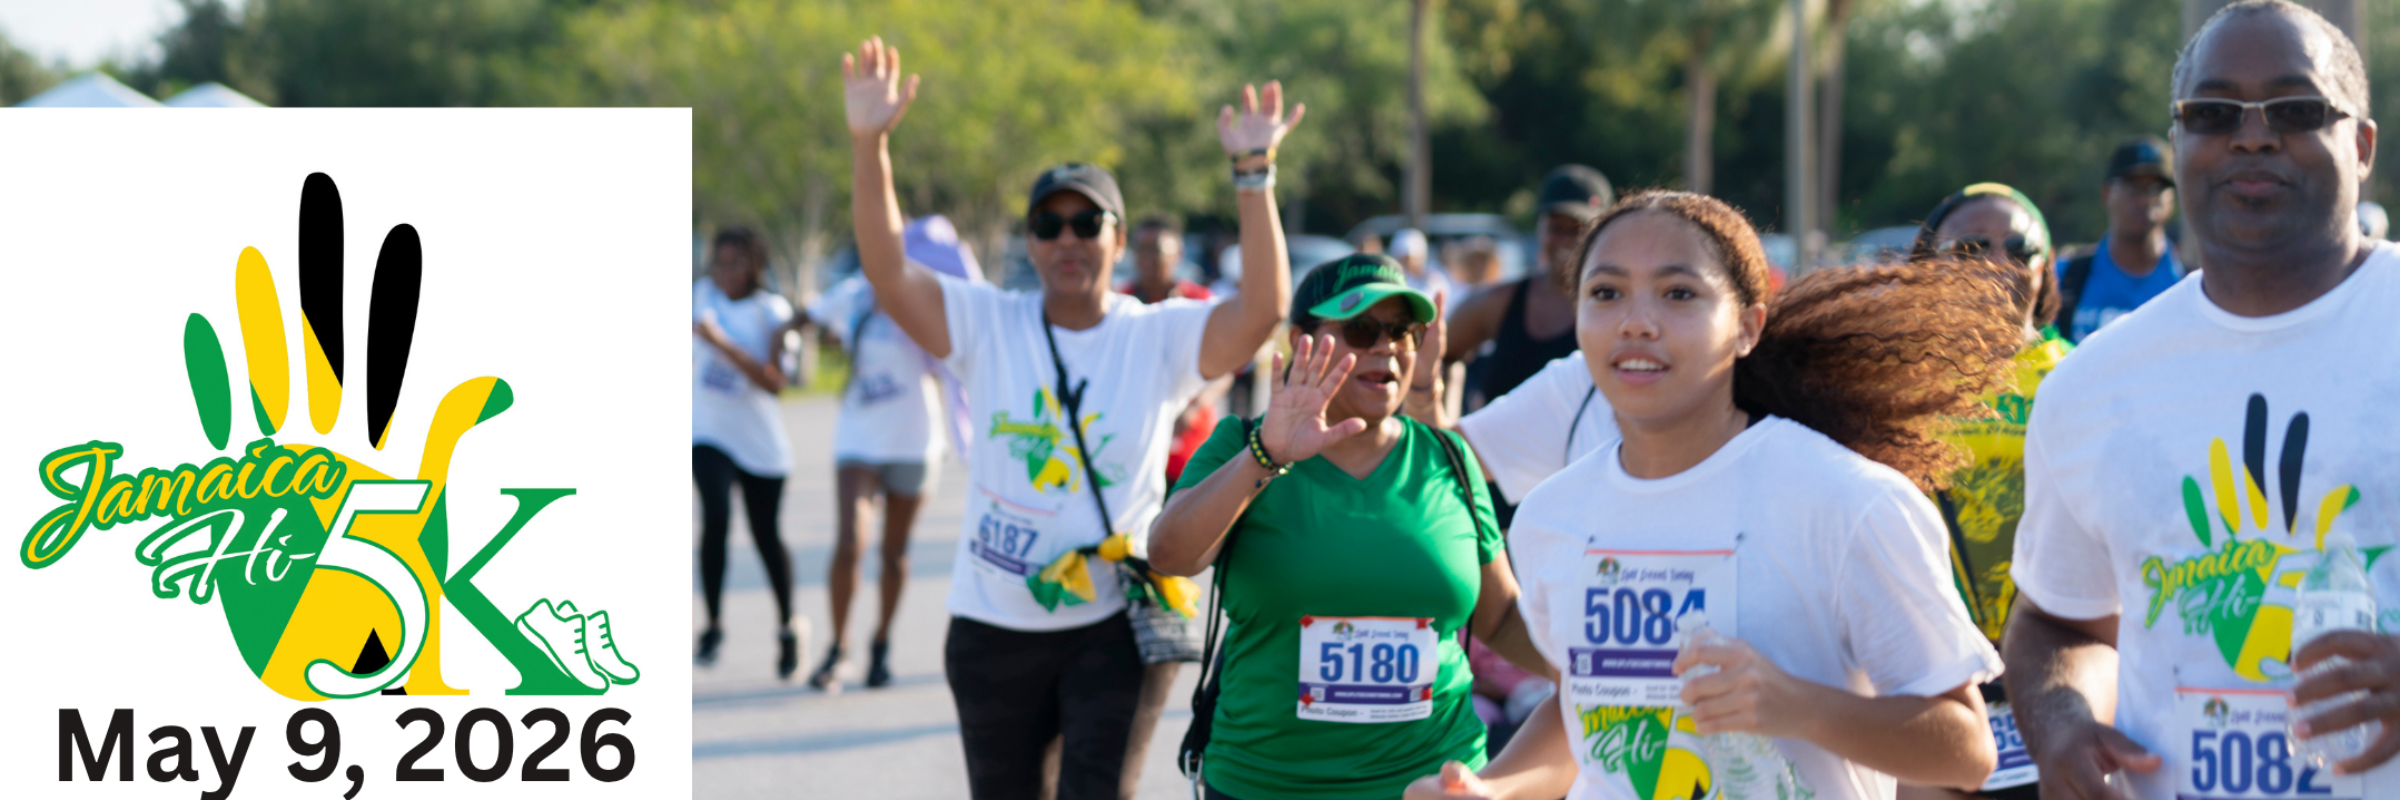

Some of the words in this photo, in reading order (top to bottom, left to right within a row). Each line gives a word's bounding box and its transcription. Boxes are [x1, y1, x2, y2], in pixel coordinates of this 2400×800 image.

[979, 512, 1038, 558] 6187
[2141, 538, 2276, 629] Jmaica
[1320, 642, 1419, 683] 5180
